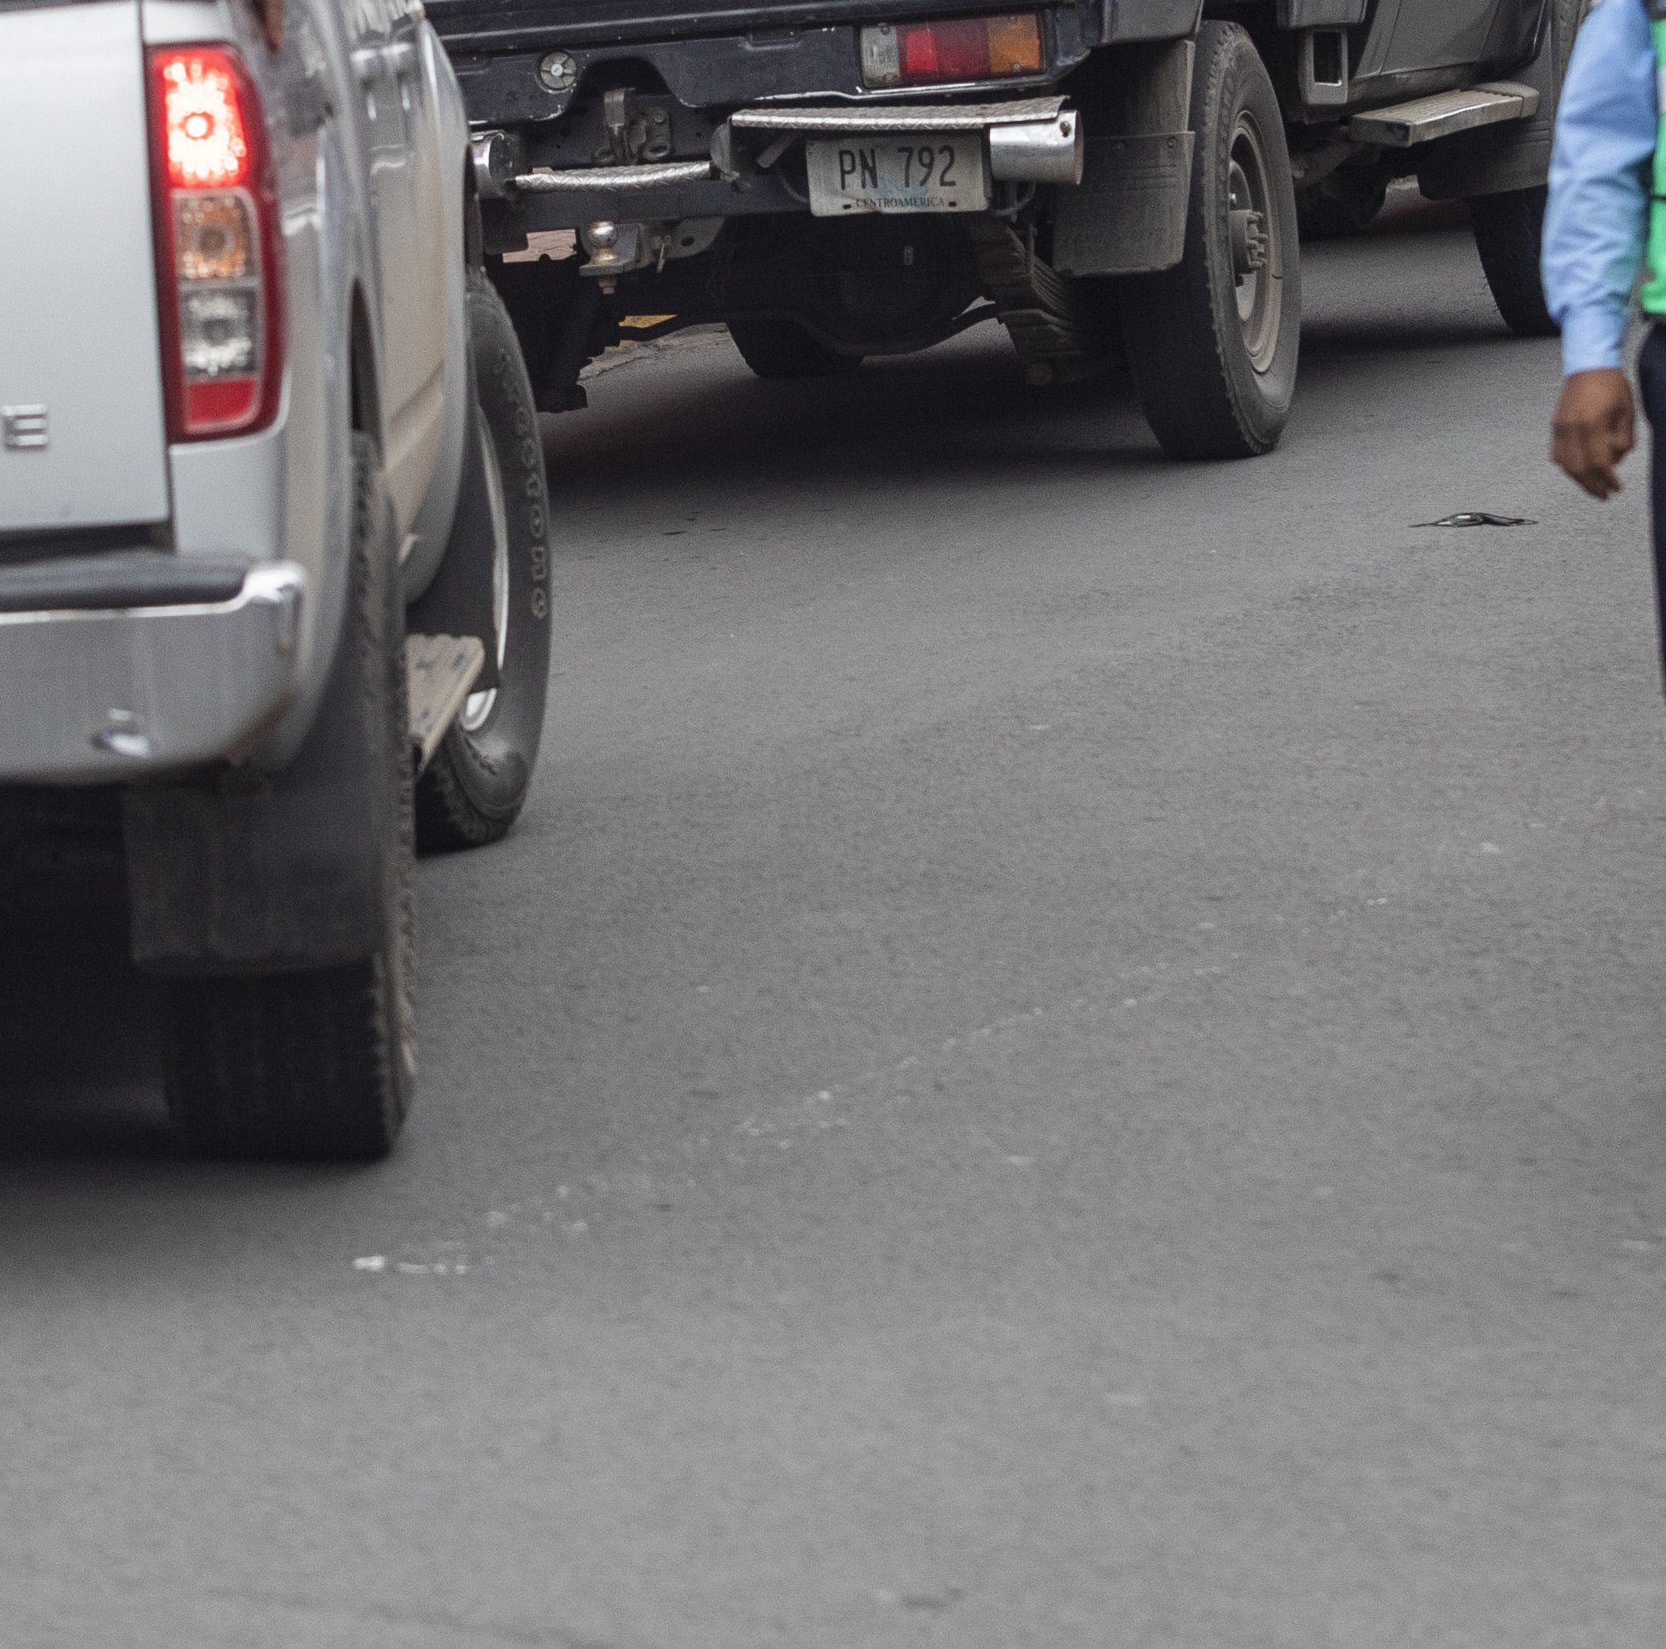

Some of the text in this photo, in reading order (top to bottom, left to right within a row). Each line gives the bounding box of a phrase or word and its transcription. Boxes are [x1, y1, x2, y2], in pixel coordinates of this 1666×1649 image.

[839, 145, 957, 191] PN 792
[856, 197, 945, 208] CENTROAMERICA
